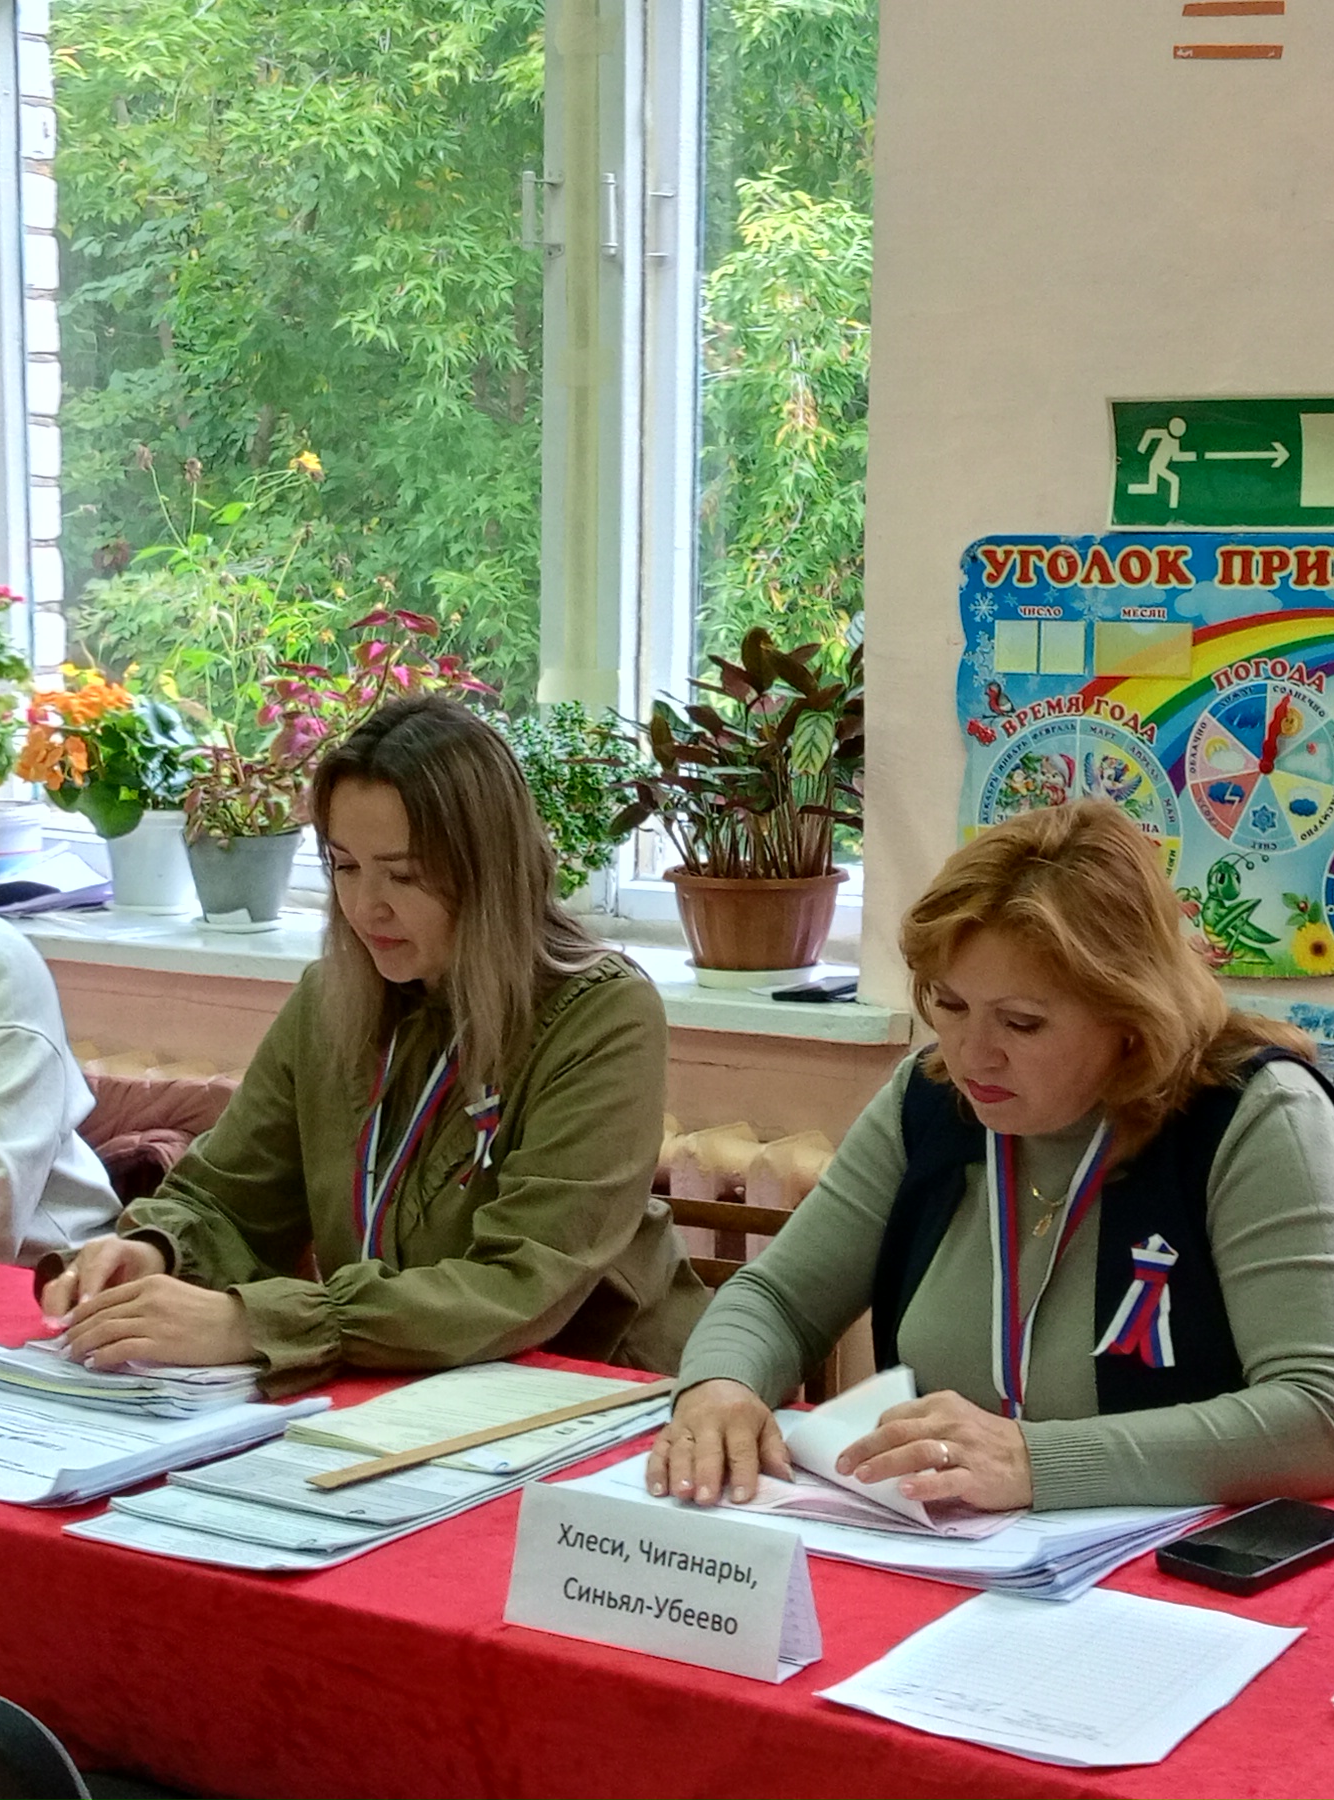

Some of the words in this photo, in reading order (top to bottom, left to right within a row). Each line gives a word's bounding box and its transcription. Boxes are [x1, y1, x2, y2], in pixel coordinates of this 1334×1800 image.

[980, 548, 1195, 586] УГОЛОК
[1018, 607, 1062, 618] ЧИСЛО
[1122, 608, 1167, 619] МЕСЯЦ
[1212, 659, 1327, 693] ПОГОДА
[1000, 695, 1083, 738] ВРЕМЯ
[1093, 697, 1157, 744] ГОДА
[1031, 723, 1076, 741] ФЕВРАЛЬ
[1089, 725, 1117, 740] МАРТ
[1189, 721, 1207, 774] ОБЛАЧНО
[557, 1523, 631, 1563] Хлеси,
[639, 1539, 758, 1589] Чиганары,
[563, 1576, 738, 1636] Синьял-Убеево
